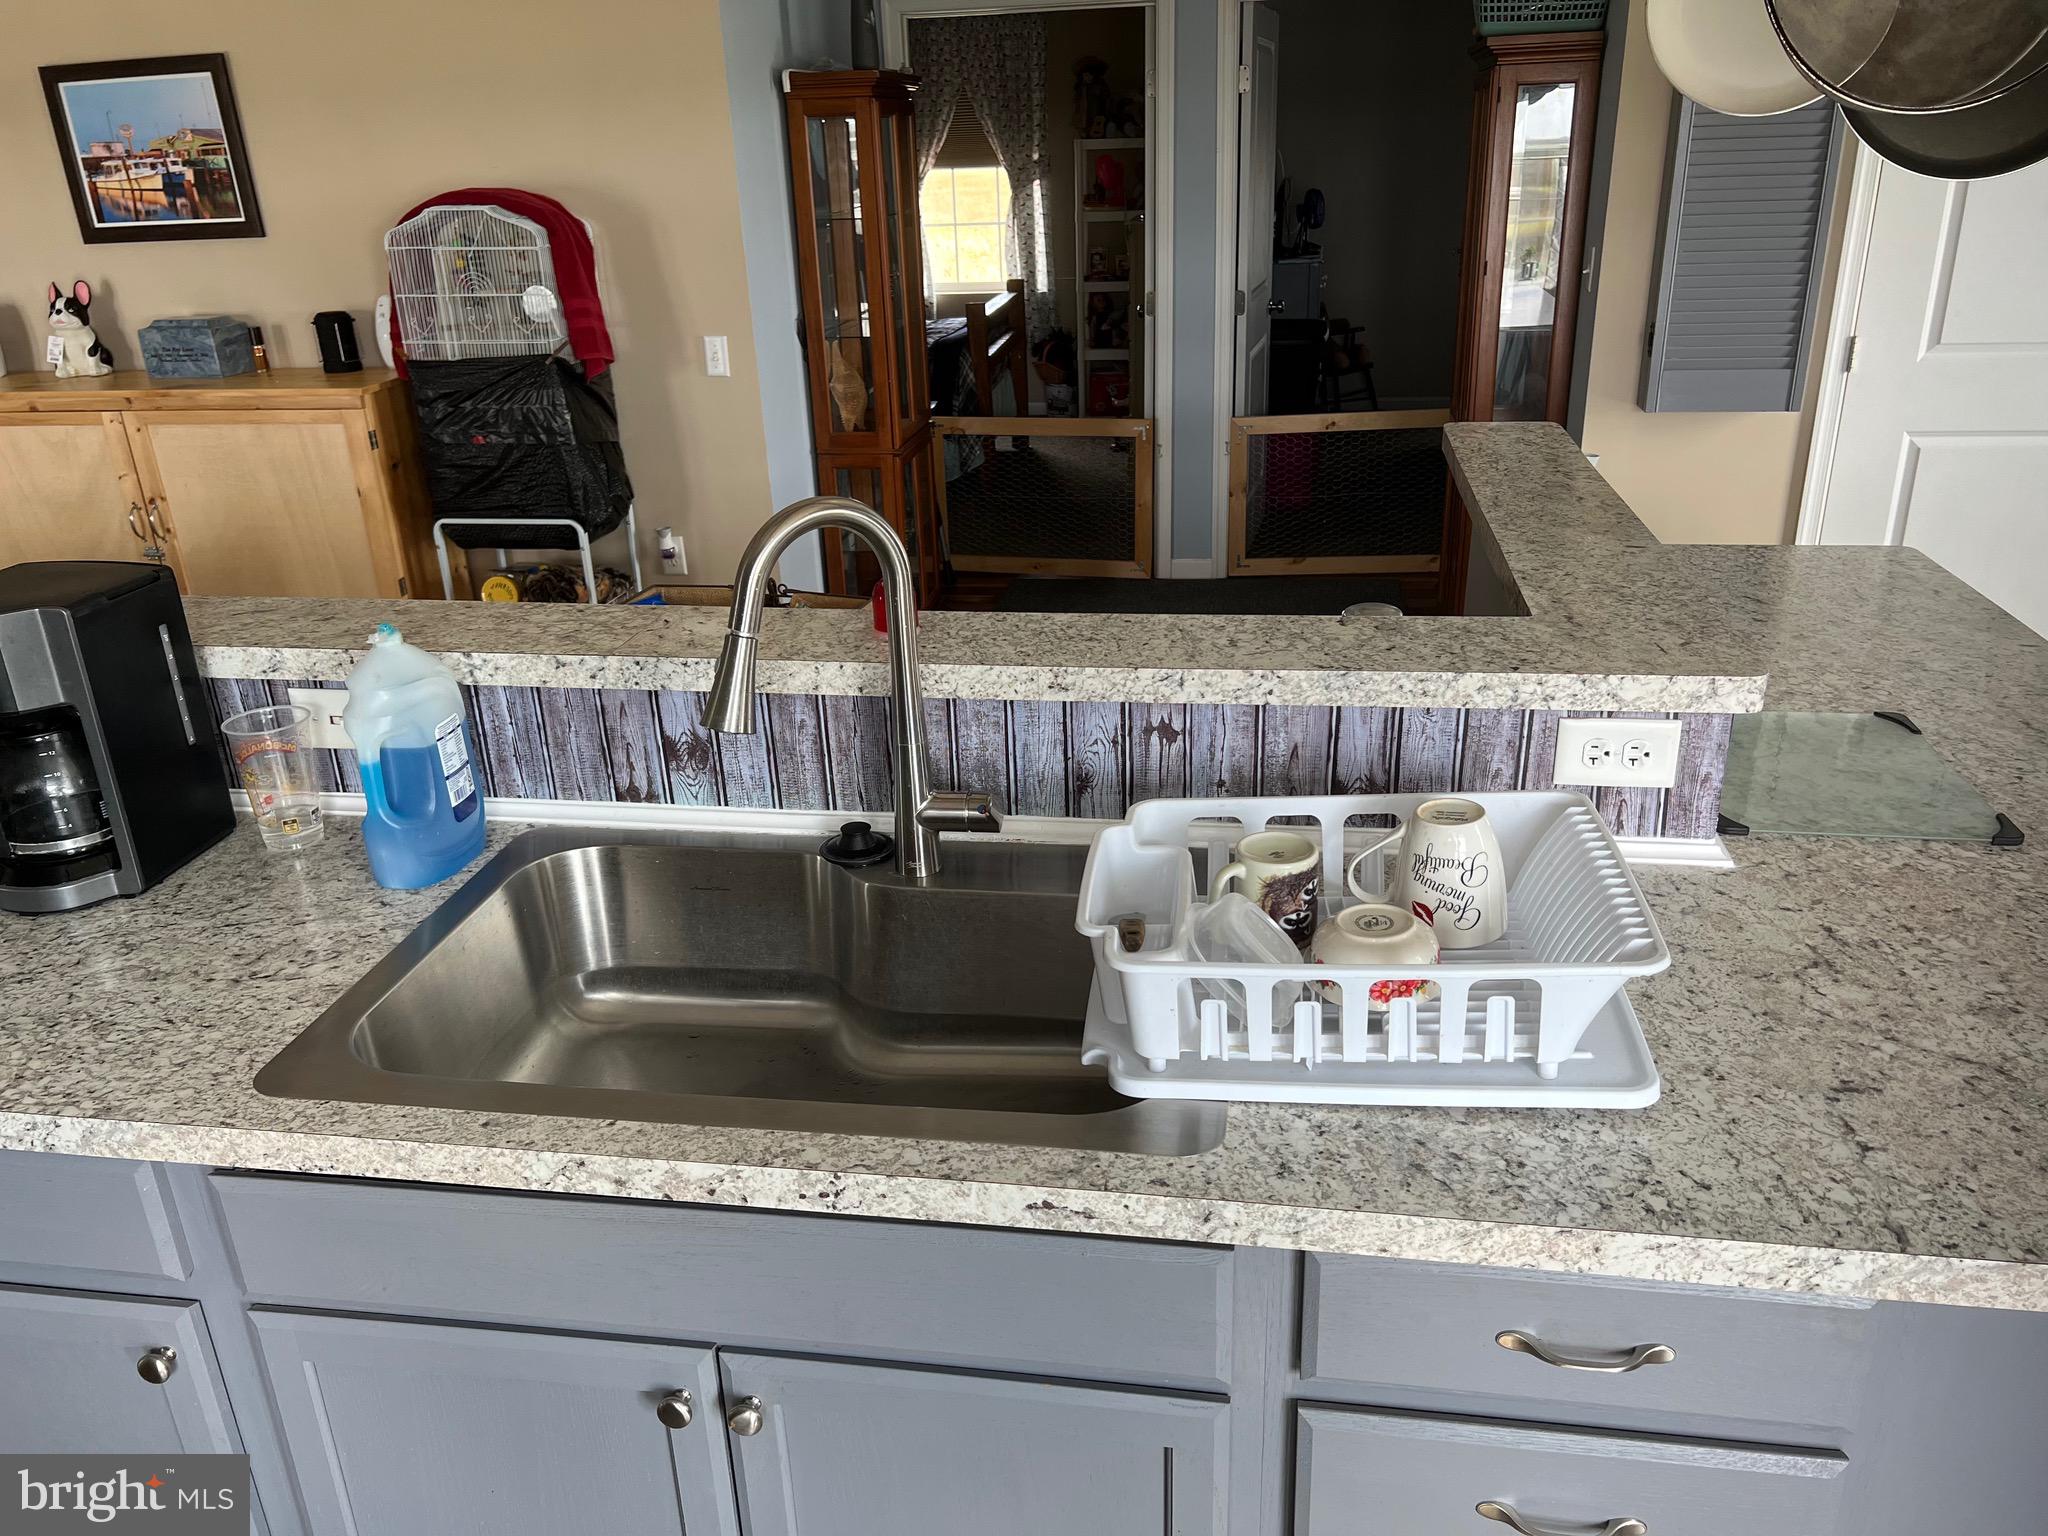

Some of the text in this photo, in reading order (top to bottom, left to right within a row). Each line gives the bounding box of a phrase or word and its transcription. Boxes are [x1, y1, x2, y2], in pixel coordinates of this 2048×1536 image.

[1411, 842, 1488, 888] Beautiful
[1413, 862, 1466, 901] morning
[1432, 896, 1481, 931] Good
